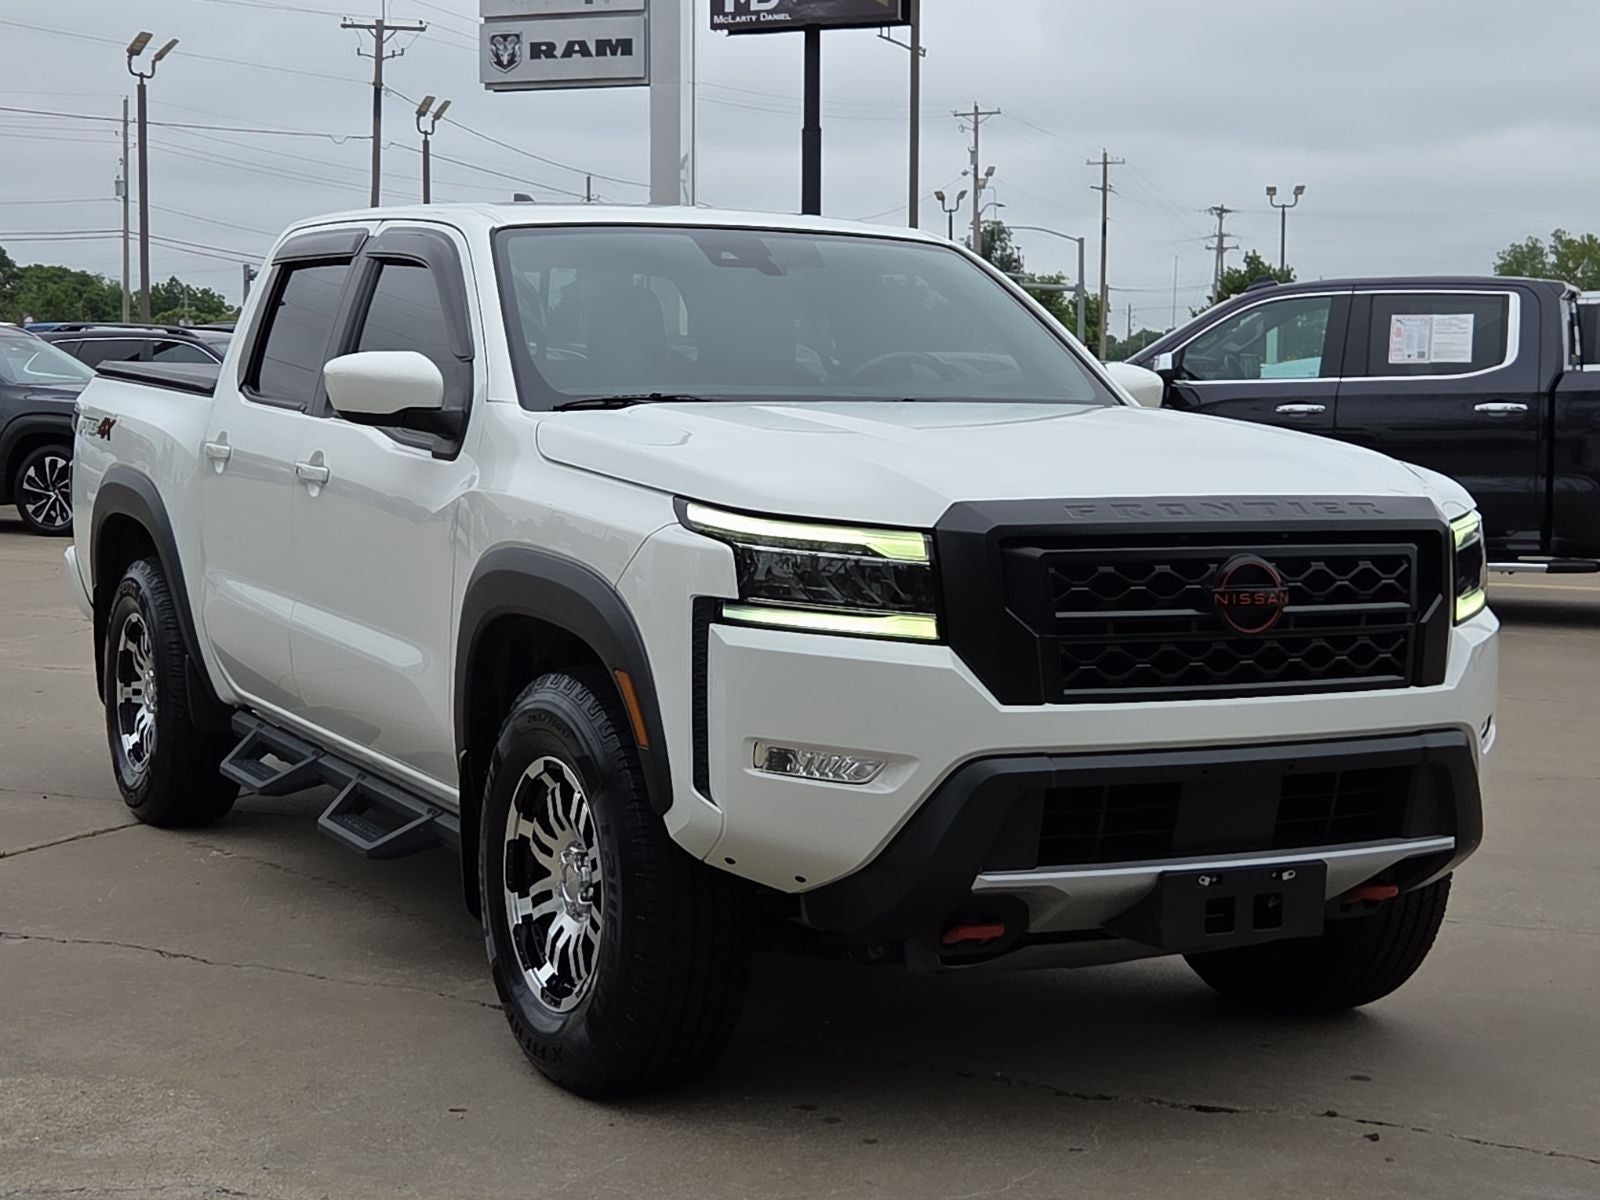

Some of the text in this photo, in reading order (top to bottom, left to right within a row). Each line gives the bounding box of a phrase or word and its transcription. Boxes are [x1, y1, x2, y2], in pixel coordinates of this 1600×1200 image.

[530, 38, 633, 60] RAM
[1064, 501, 1385, 519] FRONTIER
[1213, 592, 1289, 605] NISSAN
